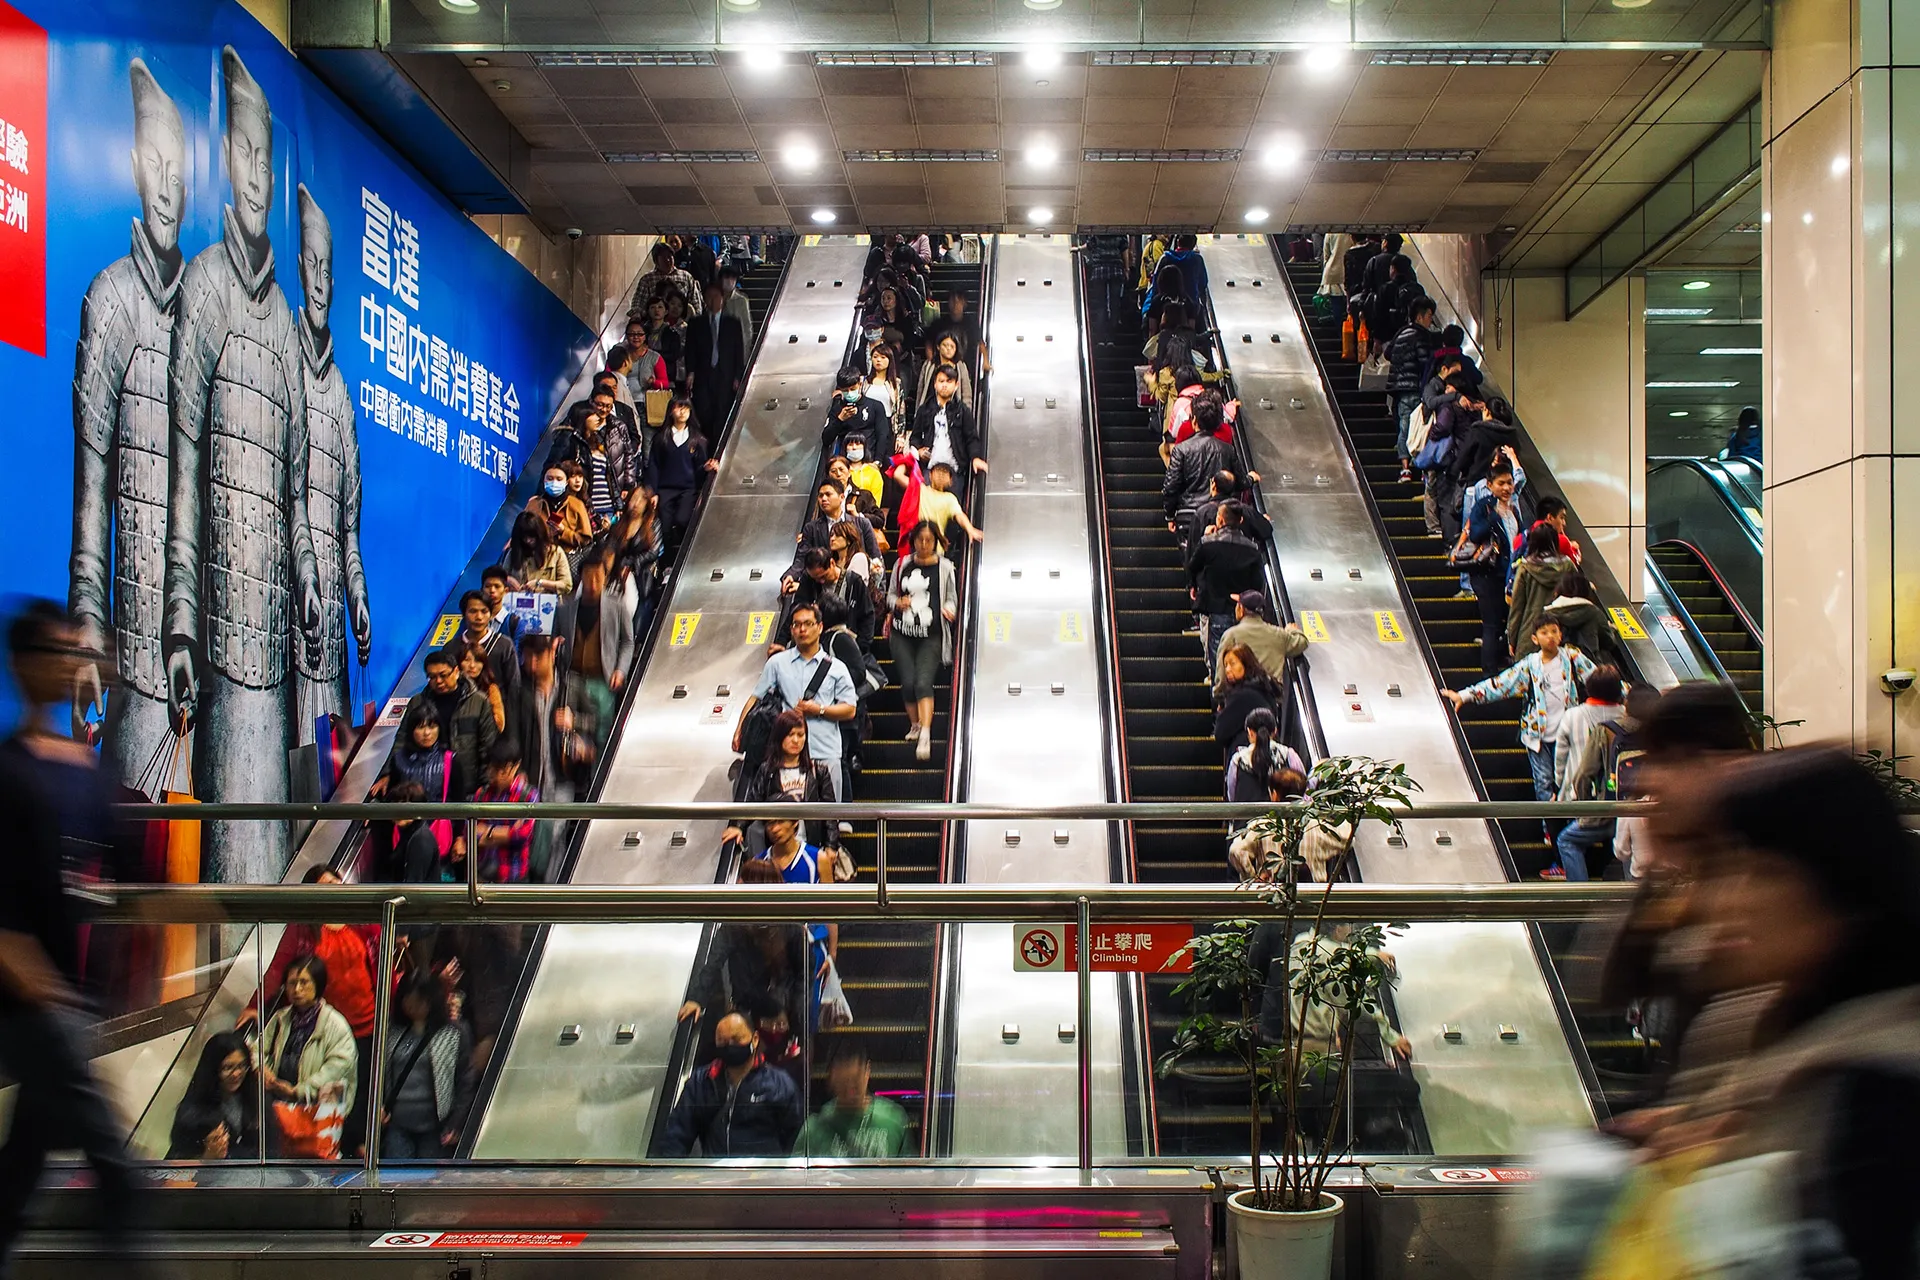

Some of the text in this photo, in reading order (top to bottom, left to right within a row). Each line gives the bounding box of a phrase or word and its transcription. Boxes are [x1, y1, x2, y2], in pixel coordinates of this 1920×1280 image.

[0, 118, 29, 175] 驗
[361, 186, 420, 312] 富達
[360, 292, 521, 445] 中國內需消費基金
[1092, 953, 1139, 964] Climbing
